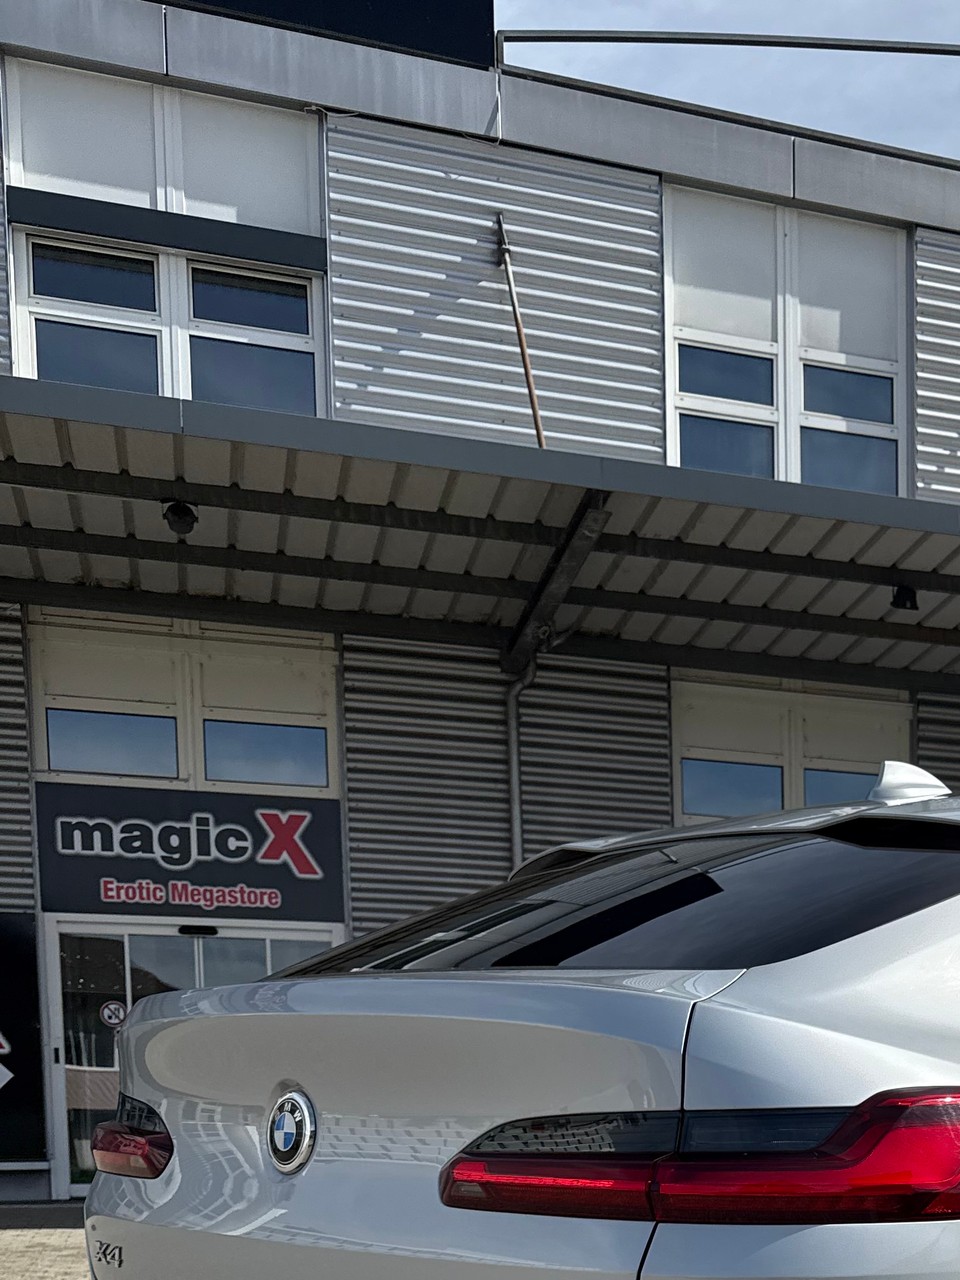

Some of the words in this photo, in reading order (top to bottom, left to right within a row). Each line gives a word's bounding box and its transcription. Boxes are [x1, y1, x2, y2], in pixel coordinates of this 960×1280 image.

[101, 878, 166, 904] Erotic
[169, 880, 281, 909] Megastore
[94, 1240, 123, 1268] X4
